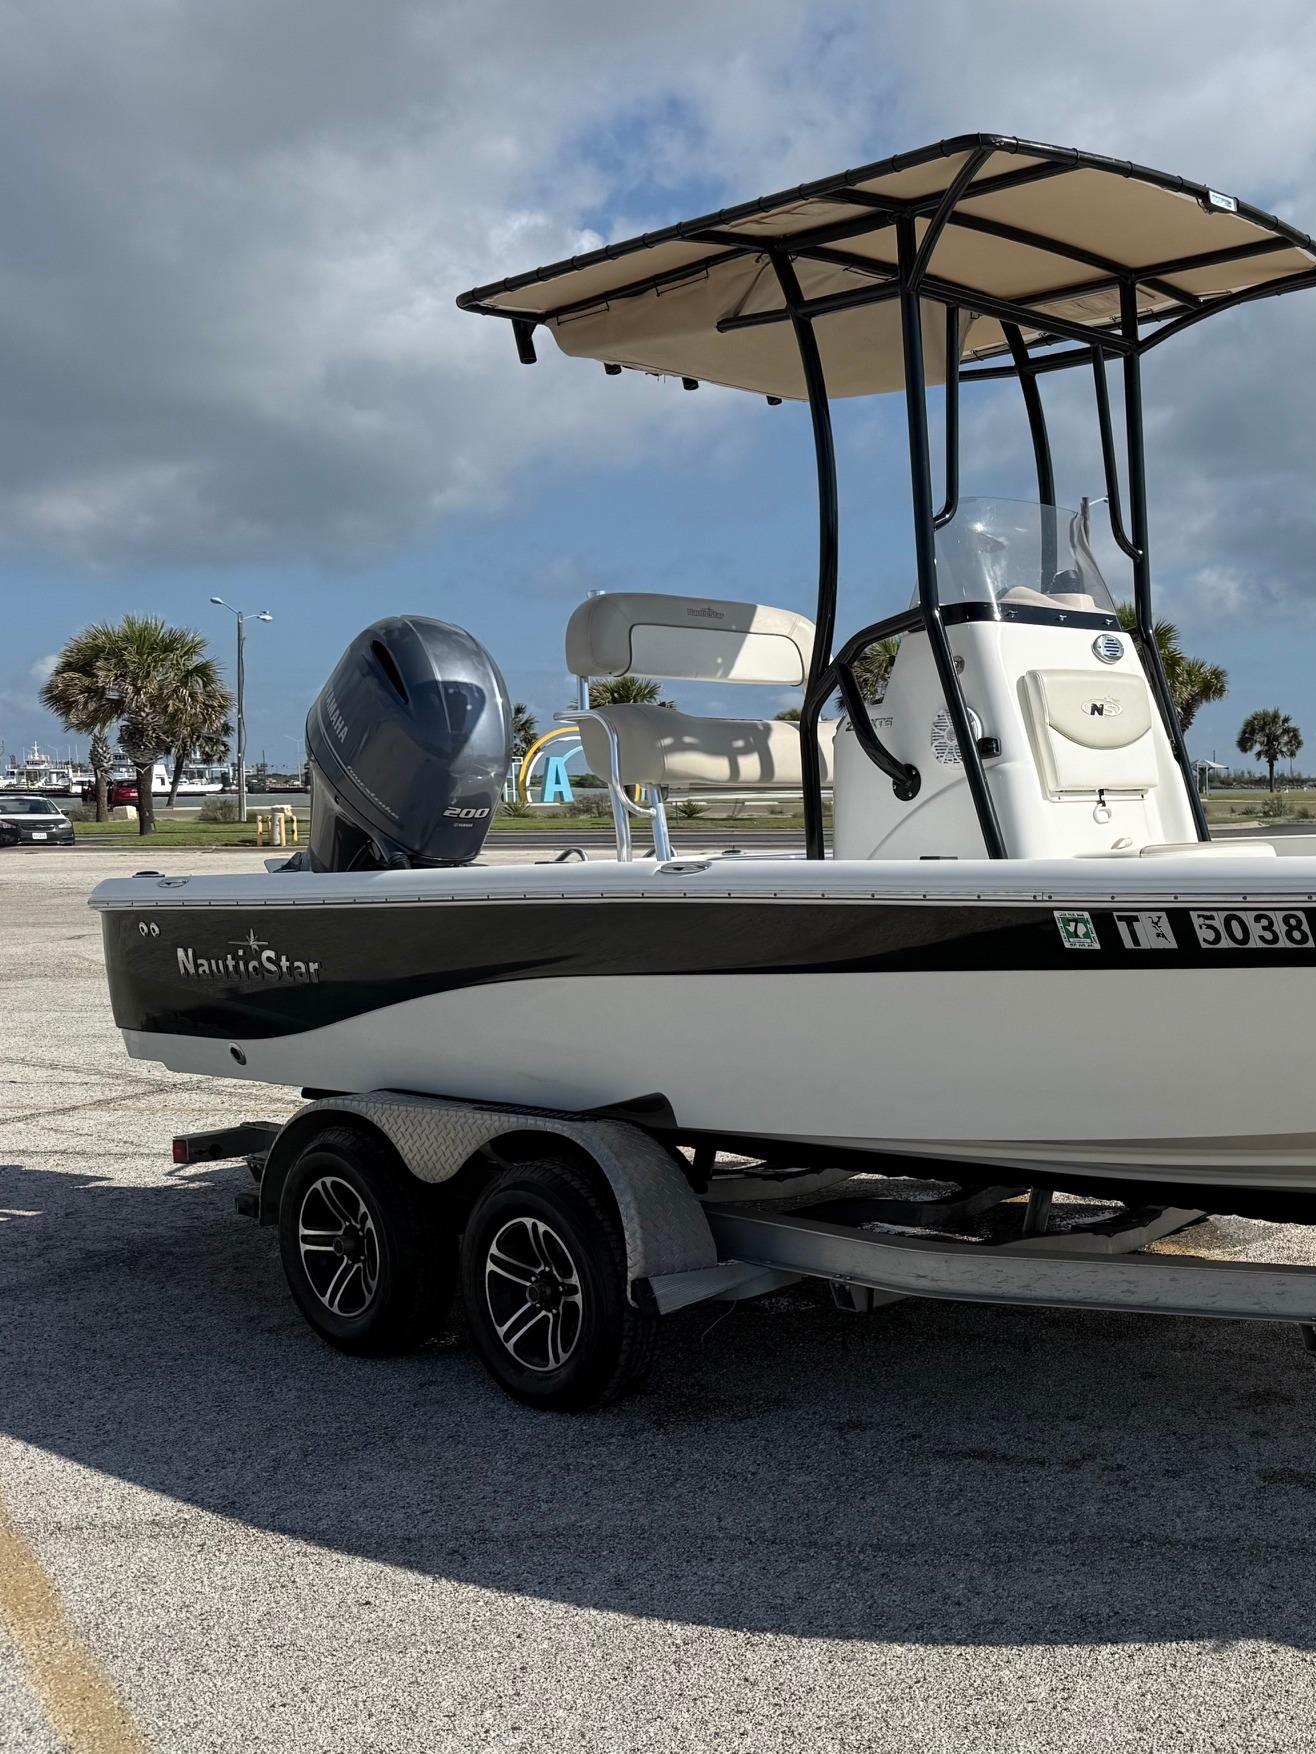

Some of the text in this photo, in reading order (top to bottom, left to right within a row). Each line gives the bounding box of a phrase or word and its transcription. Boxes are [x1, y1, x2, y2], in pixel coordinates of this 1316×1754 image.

[443, 806, 490, 818] 200
[1197, 913, 1310, 947] 5038
[177, 948, 321, 983] NauticStar
